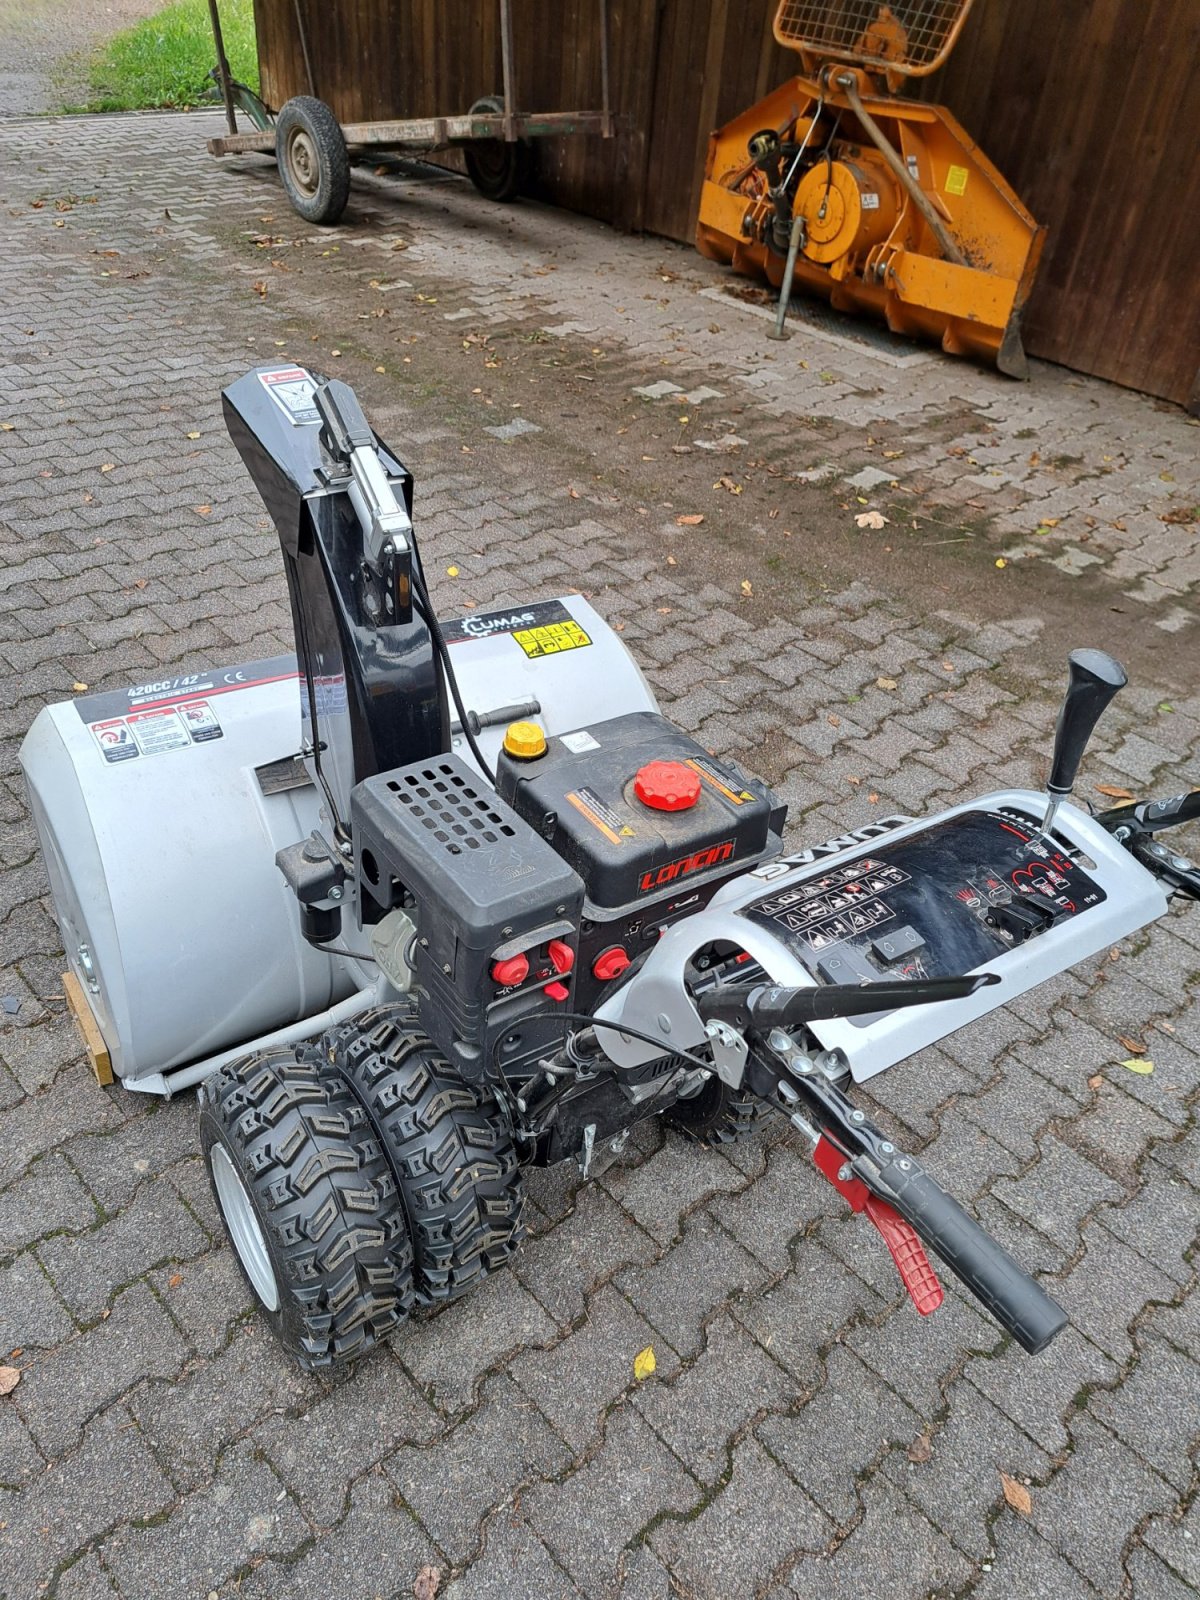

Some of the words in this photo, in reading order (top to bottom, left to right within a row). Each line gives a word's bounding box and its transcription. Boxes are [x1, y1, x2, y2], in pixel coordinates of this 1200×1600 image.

[469, 612, 535, 631] LUMAG
[128, 680, 171, 697] 420CC
[750, 814, 914, 881] LUMAG
